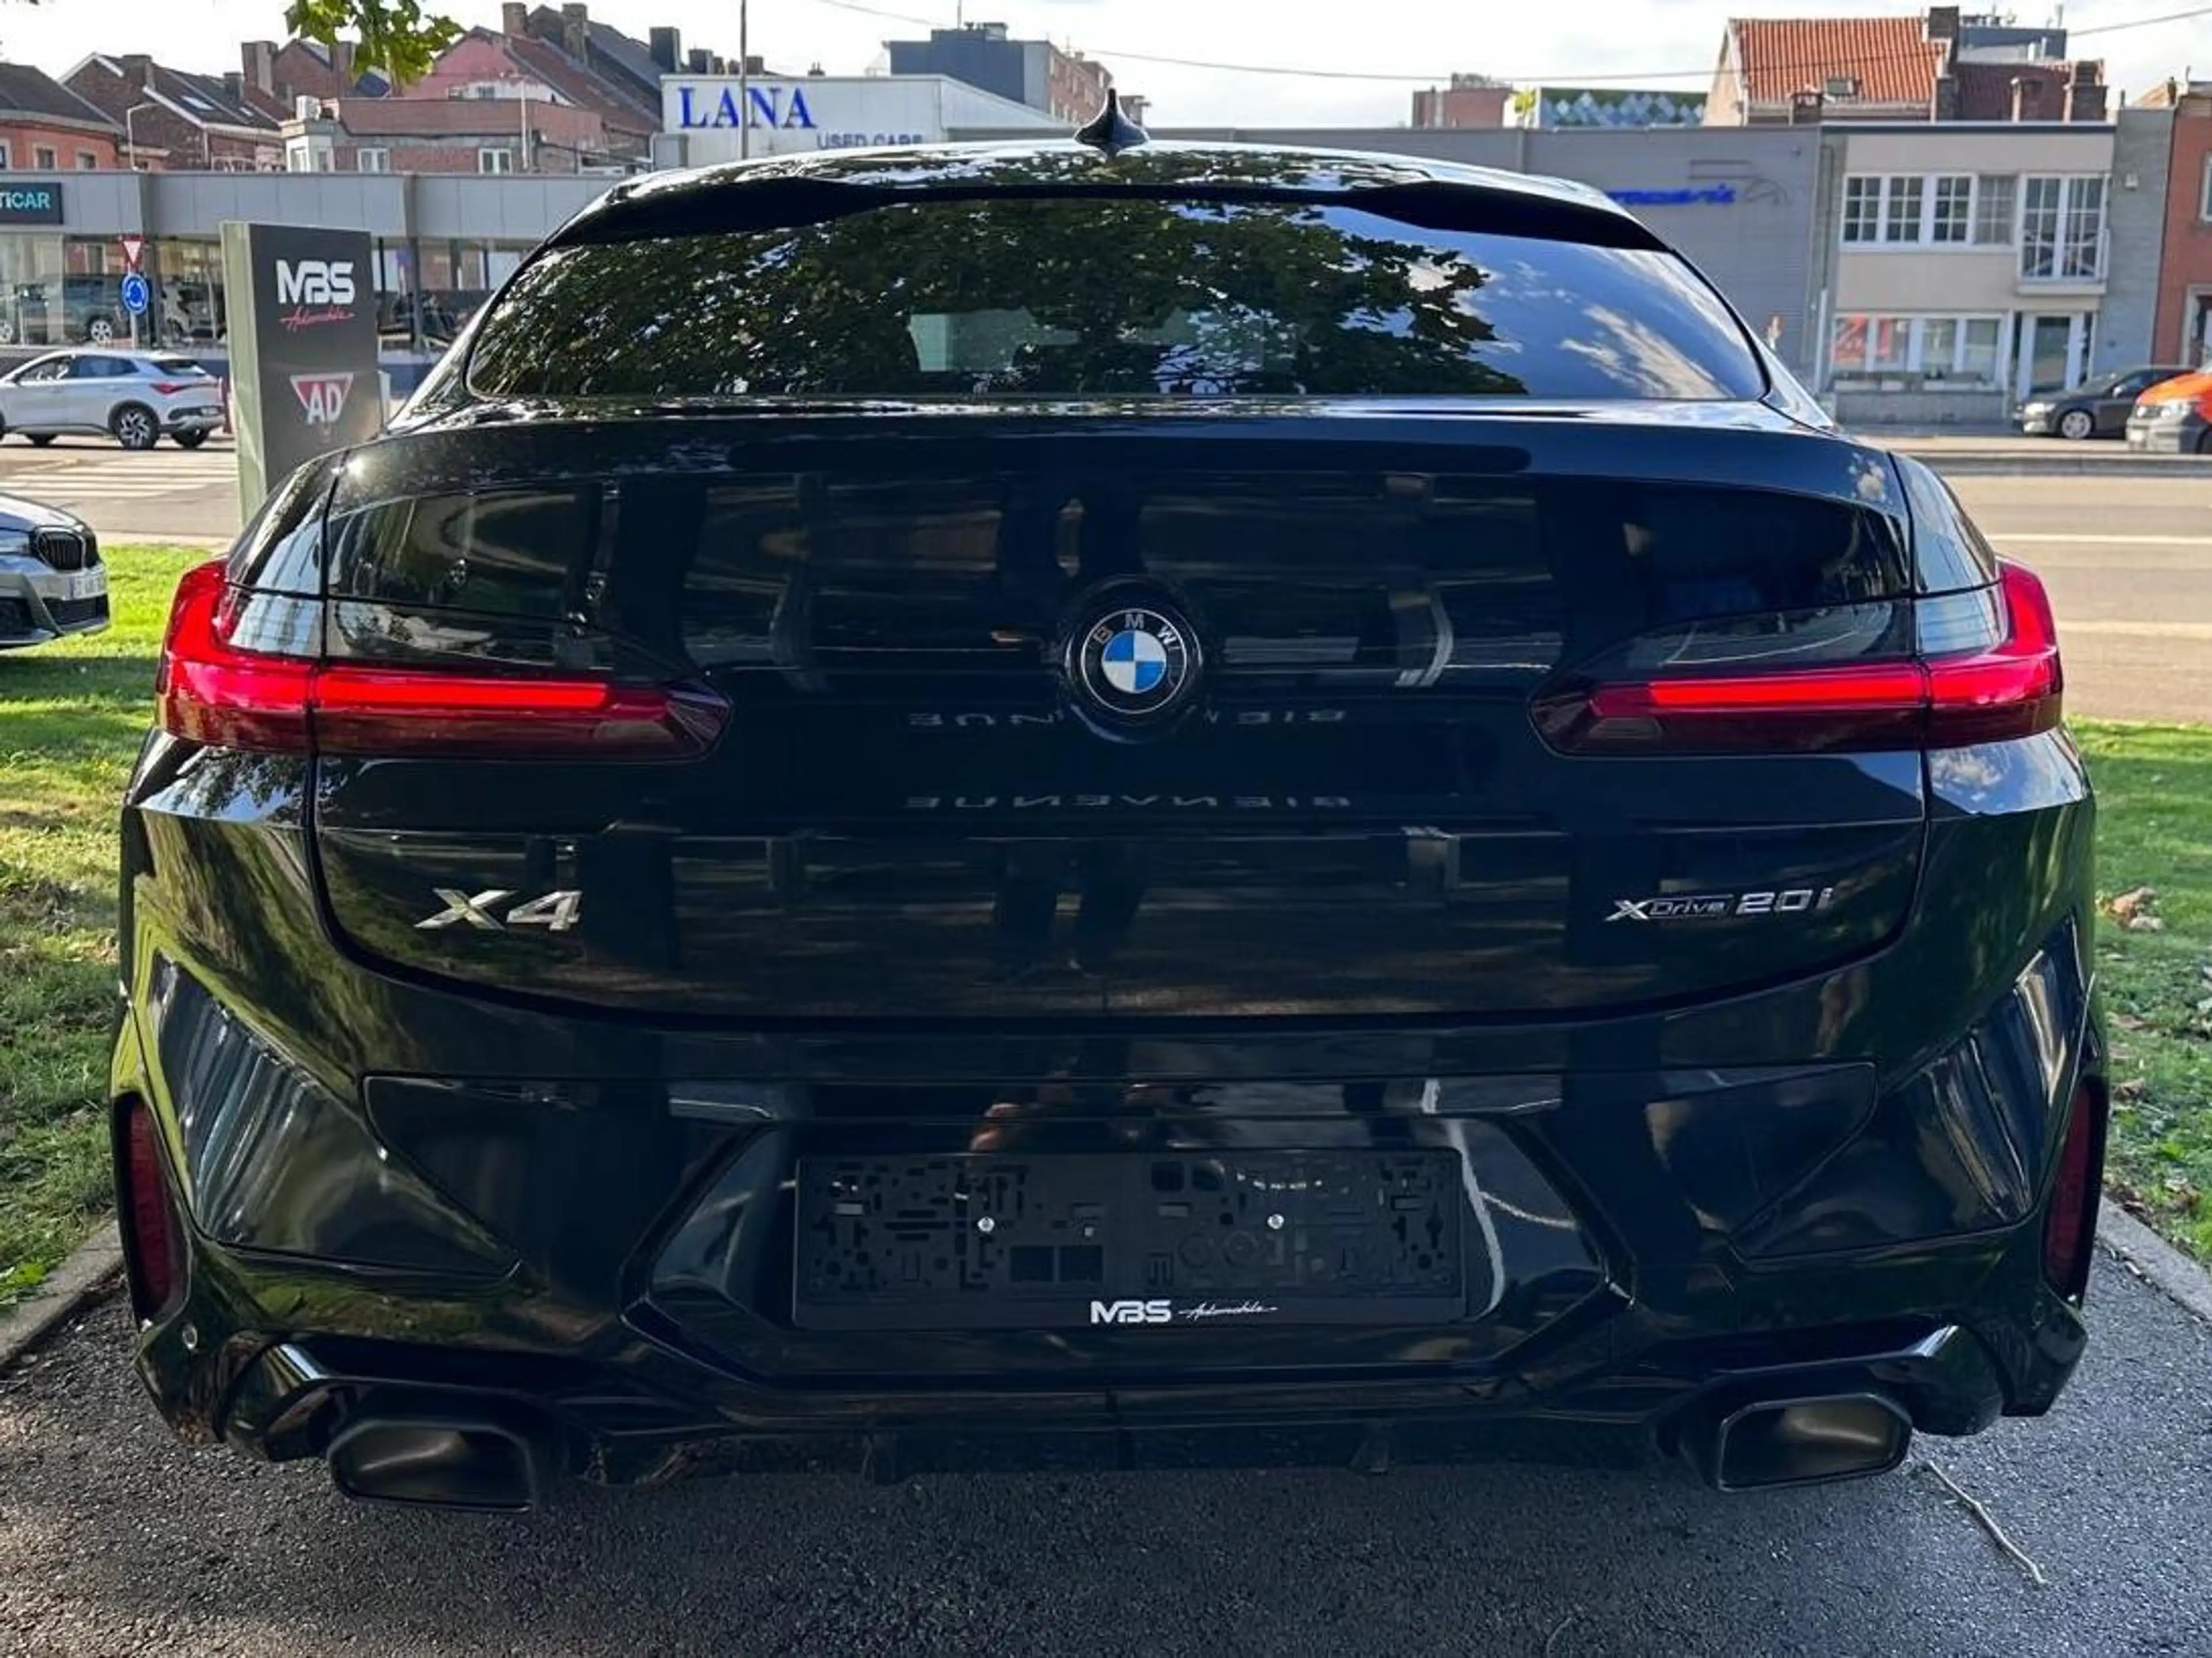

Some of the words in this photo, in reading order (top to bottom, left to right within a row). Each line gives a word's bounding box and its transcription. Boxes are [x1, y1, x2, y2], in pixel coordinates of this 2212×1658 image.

[678, 86, 818, 128] LANA
[817, 132, 869, 150] USED
[276, 260, 355, 305] MBS
[307, 382, 342, 425] AD
[1092, 613, 1177, 646] BMW
[414, 887, 583, 931] X4
[1090, 1300, 1172, 1323] MBS
